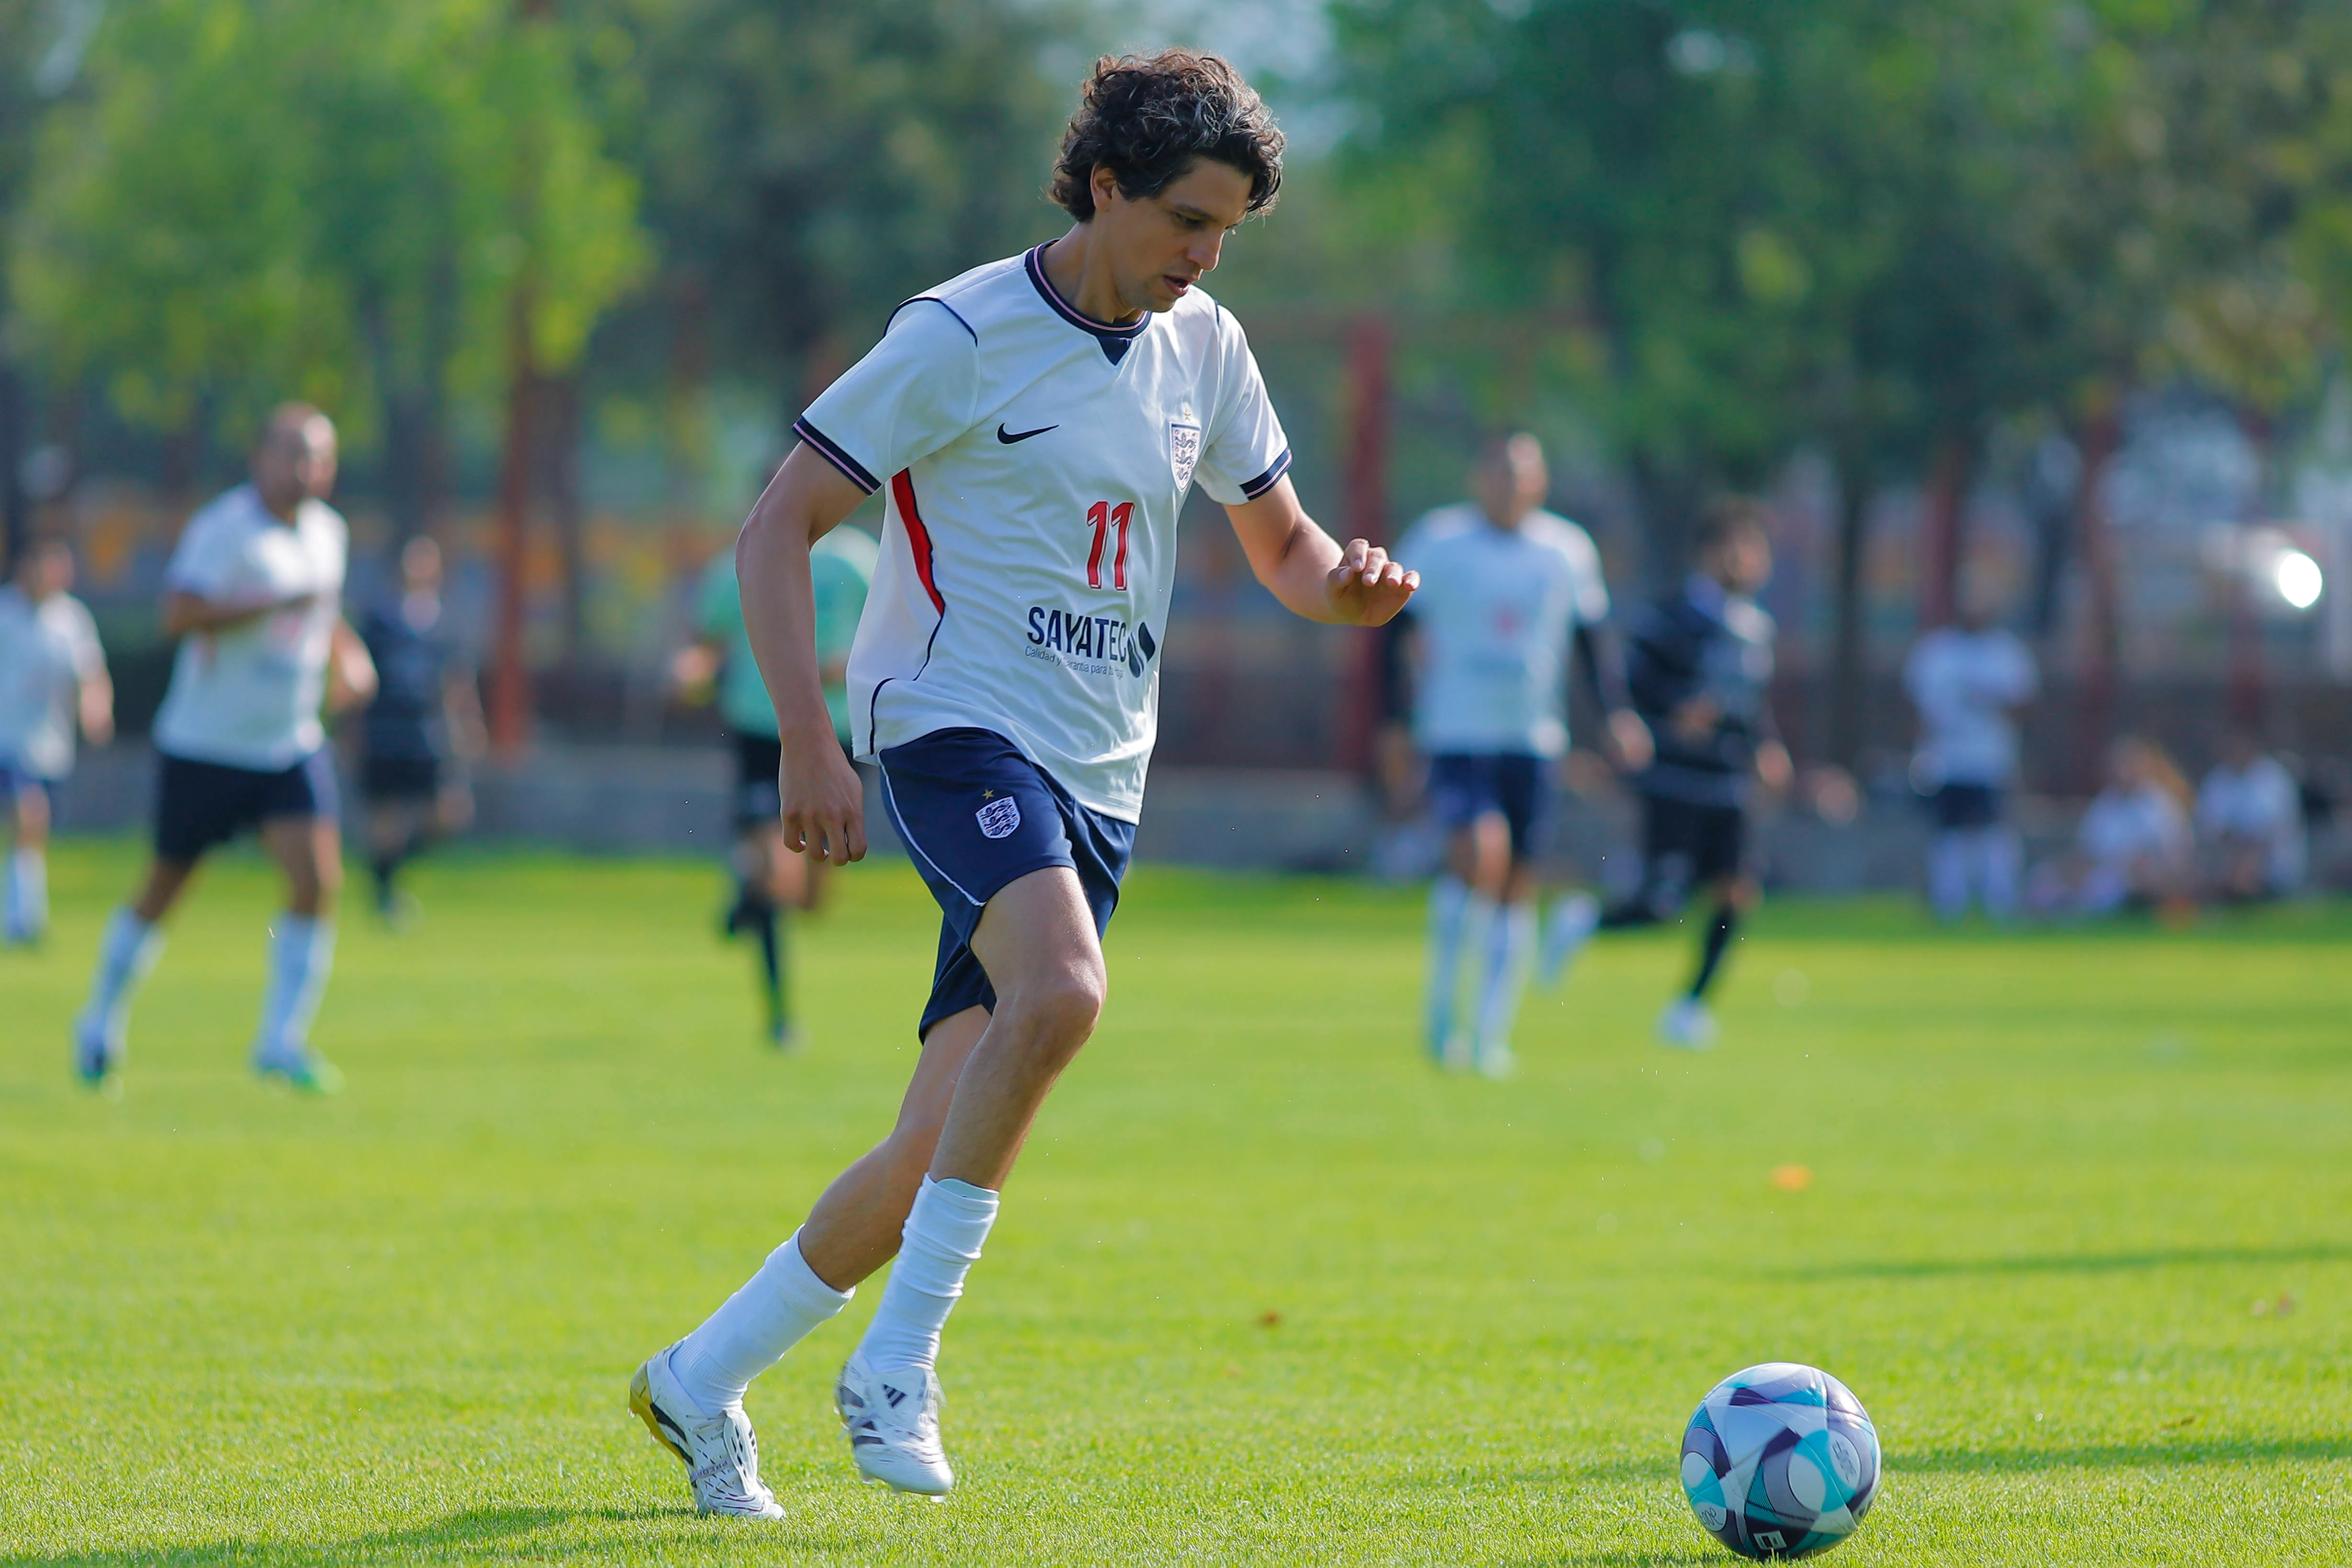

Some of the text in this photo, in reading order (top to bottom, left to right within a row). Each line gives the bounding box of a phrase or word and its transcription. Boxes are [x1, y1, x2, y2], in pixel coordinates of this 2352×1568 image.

[1086, 501, 1135, 590] 11
[1025, 645, 1055, 662] Calidad
[1057, 657, 1062, 666] y
[1062, 657, 1089, 672] arantía
[1090, 665, 1107, 675] para
[1027, 607, 1127, 663] SAYATEC
